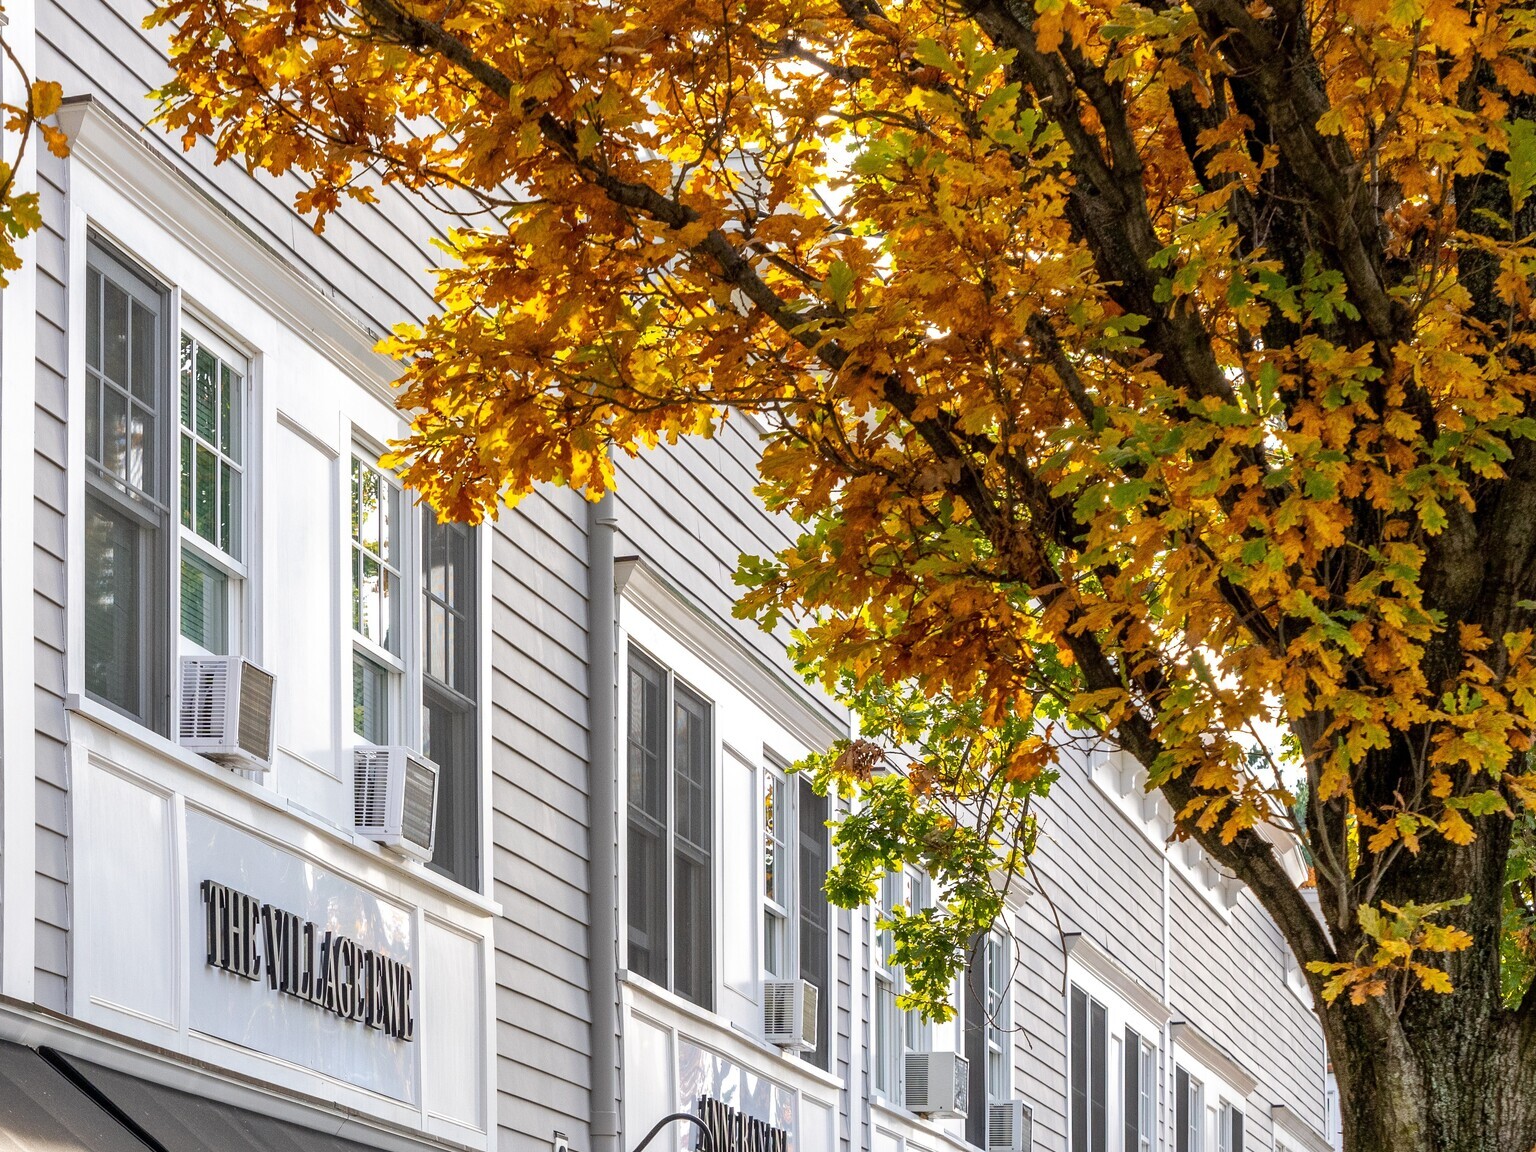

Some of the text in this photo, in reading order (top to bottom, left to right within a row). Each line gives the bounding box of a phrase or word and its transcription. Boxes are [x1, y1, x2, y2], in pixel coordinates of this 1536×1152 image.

[201, 879, 413, 1042] THE VILLAGE EWE
